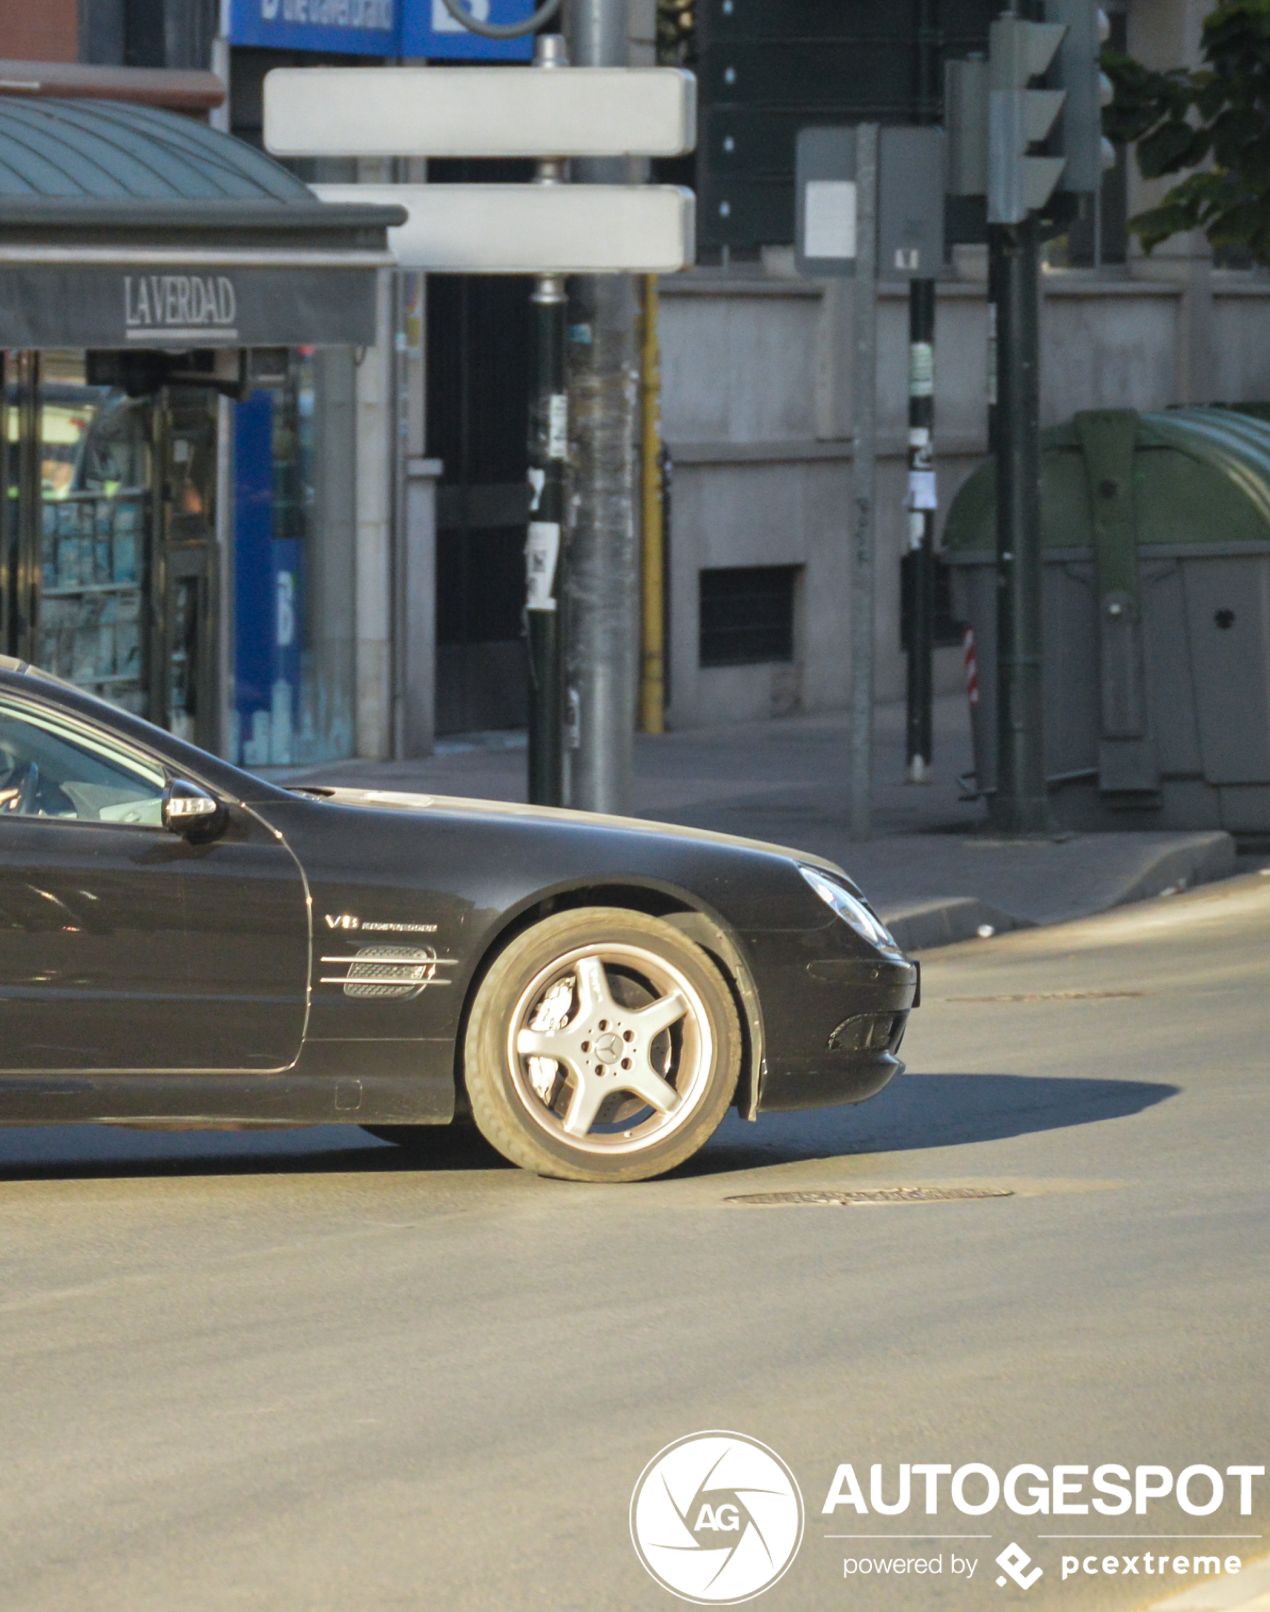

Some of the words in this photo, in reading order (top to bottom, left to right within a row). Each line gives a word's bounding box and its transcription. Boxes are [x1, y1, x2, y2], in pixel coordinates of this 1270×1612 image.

[124, 275, 151, 325] LA
[150, 275, 237, 325] VERDAD
[324, 914, 359, 929] V8
